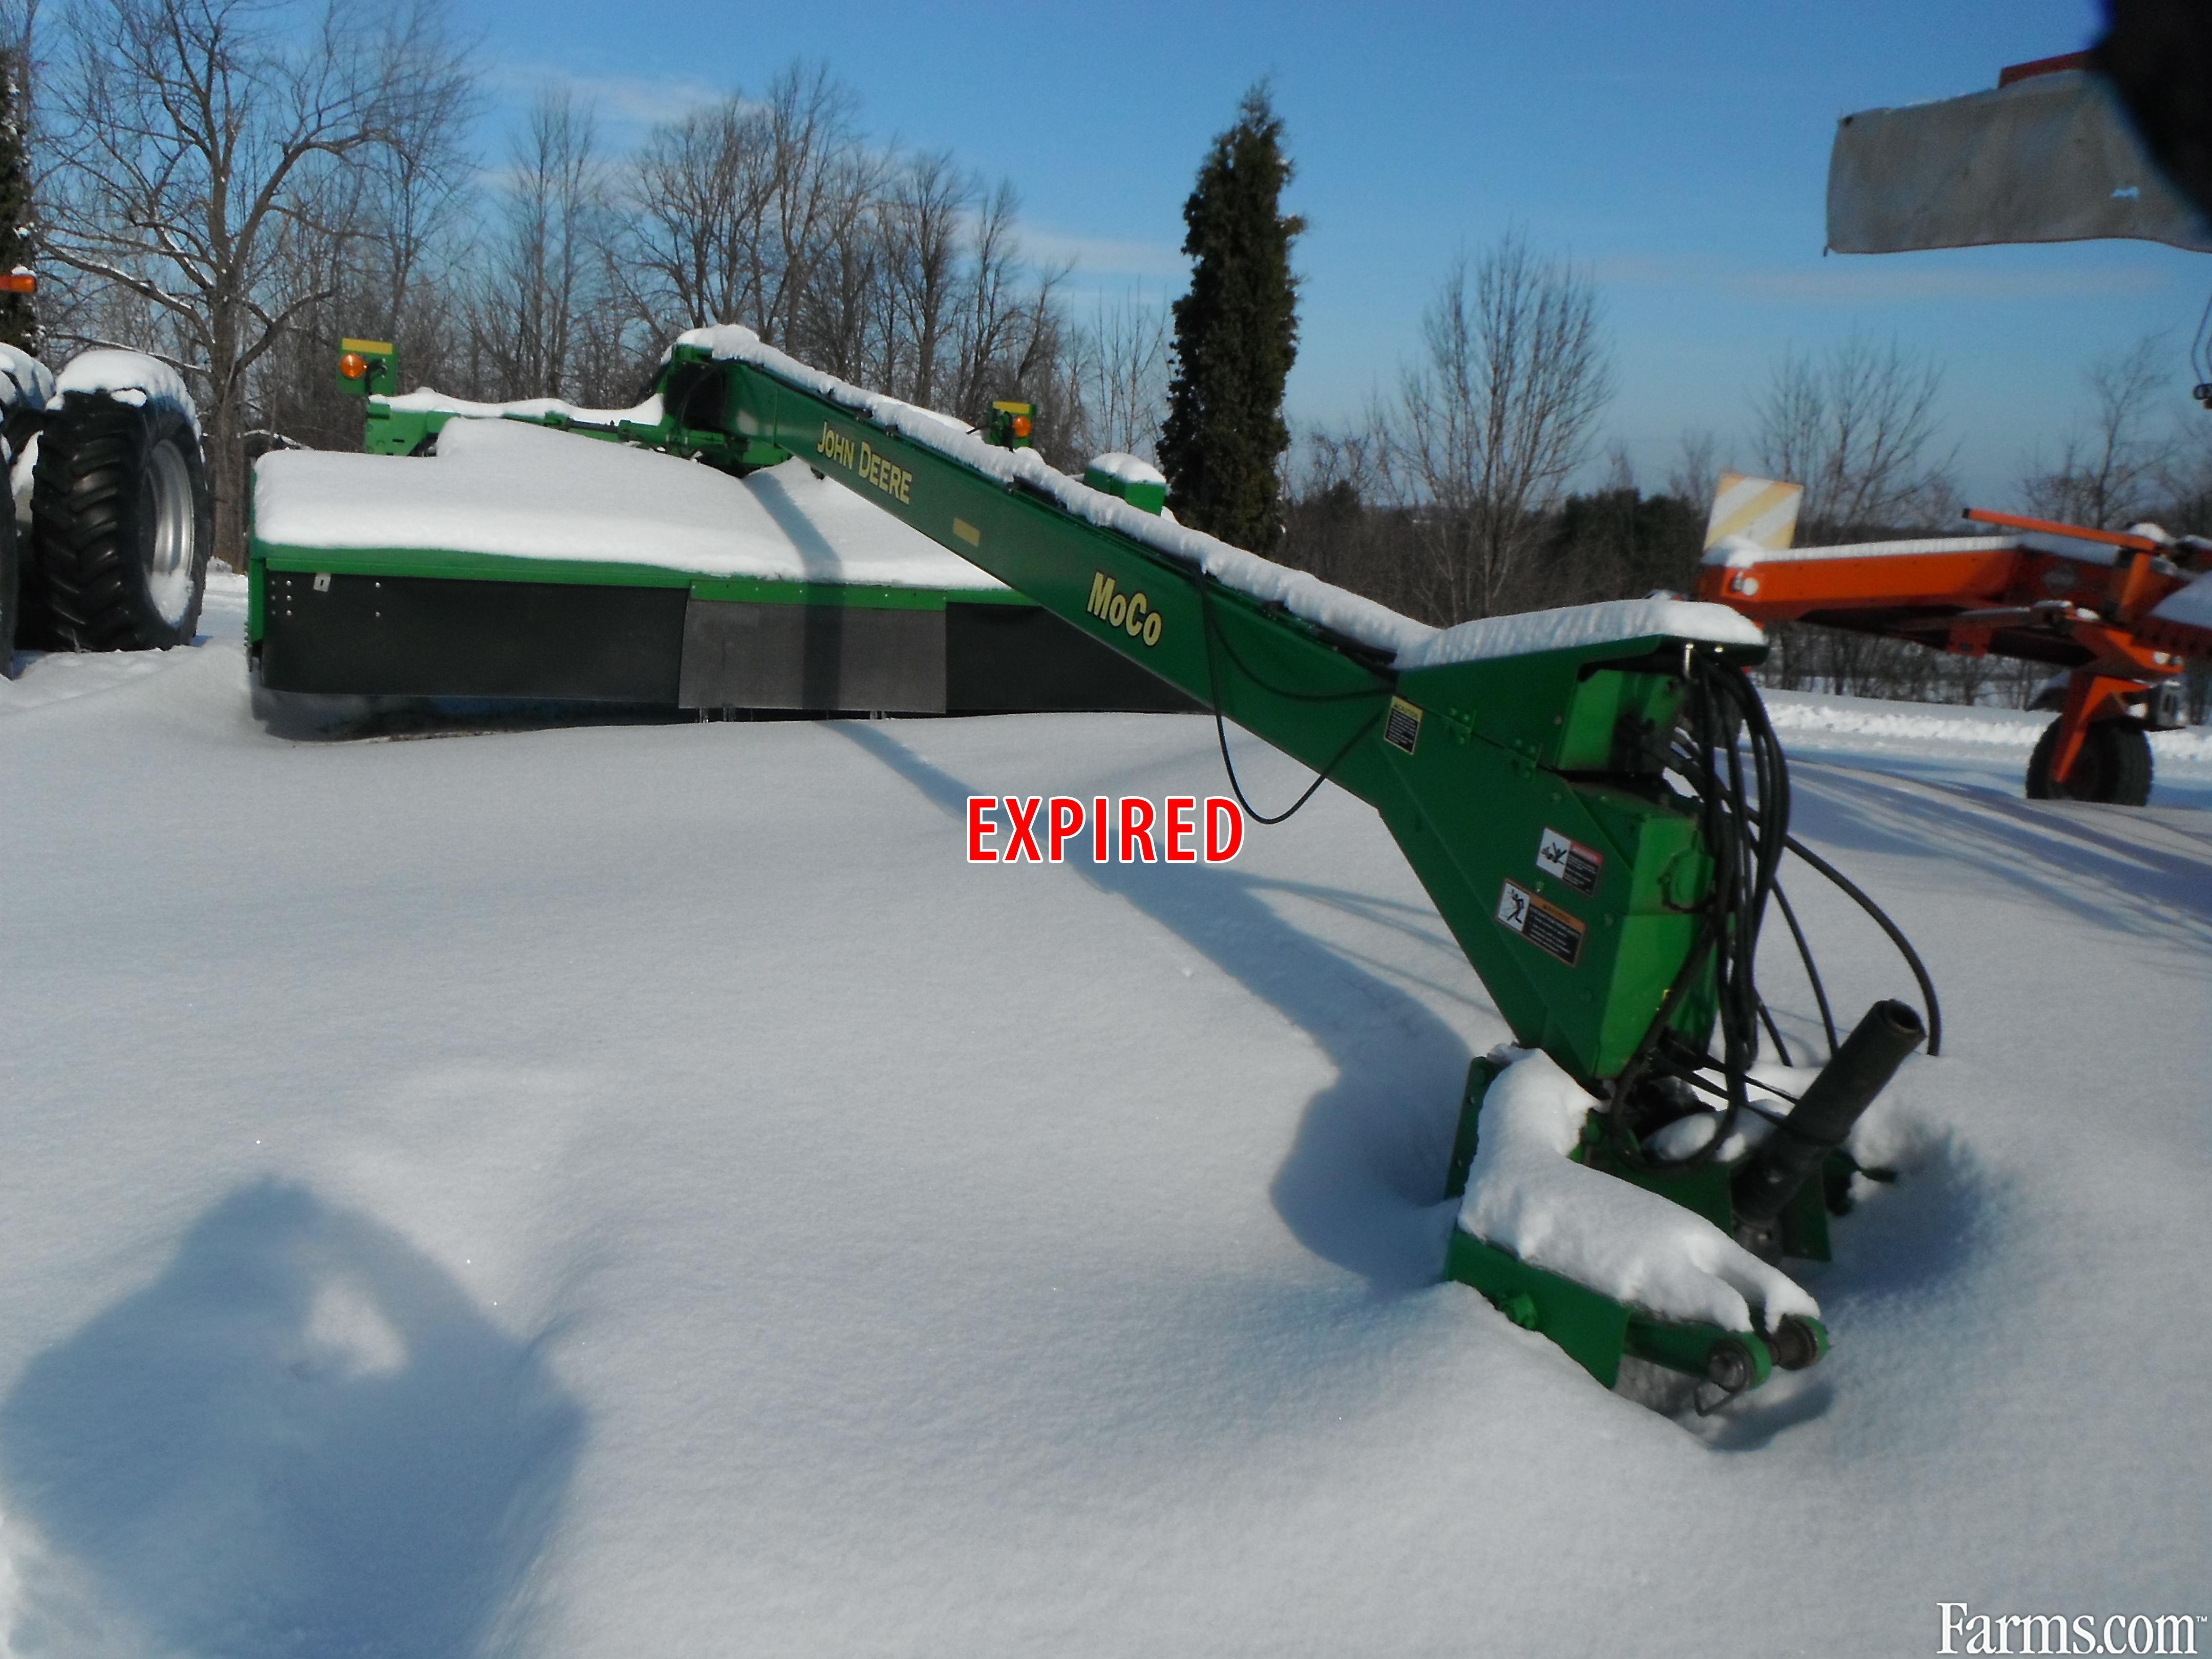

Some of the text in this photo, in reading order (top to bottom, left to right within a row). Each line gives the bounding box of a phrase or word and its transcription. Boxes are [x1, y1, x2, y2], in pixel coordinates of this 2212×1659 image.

[817, 421, 912, 505] JOHN DEERE
[1087, 571, 1162, 647] MoCo
